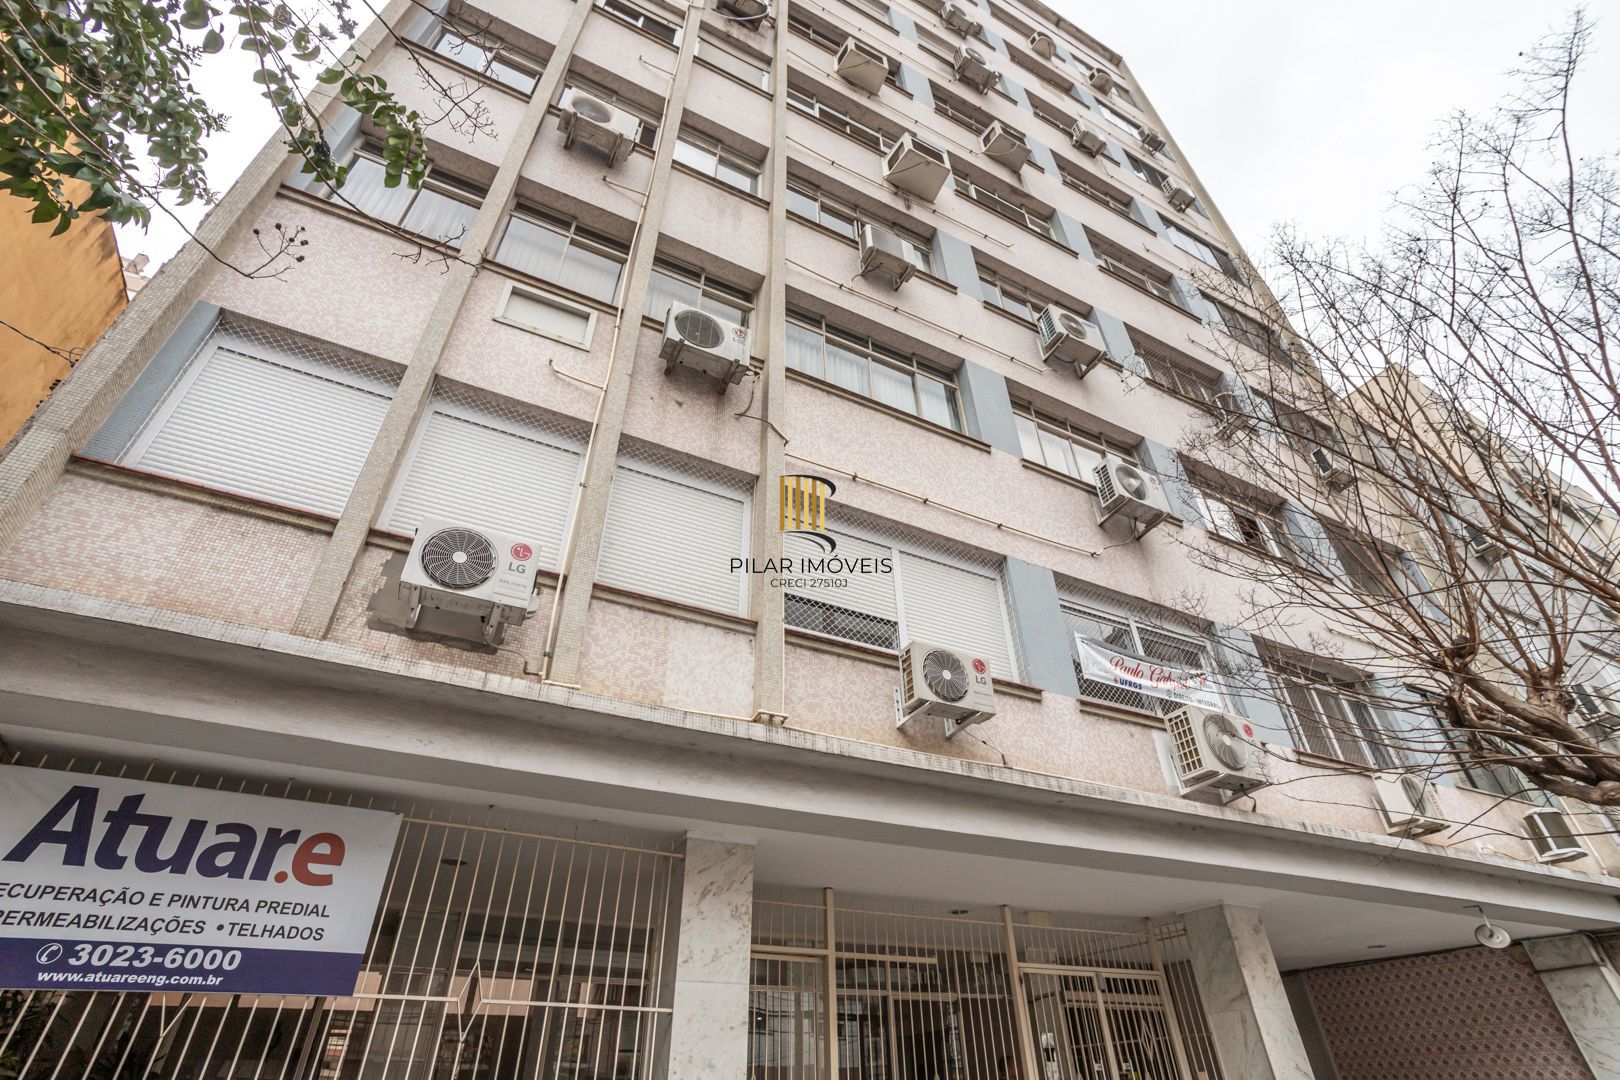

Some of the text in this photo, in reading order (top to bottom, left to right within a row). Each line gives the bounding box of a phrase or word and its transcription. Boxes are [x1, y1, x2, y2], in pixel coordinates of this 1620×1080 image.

[508, 562, 527, 574] LG
[1110, 655, 1144, 680] Paulo
[976, 675, 987, 686] LG
[1119, 678, 1143, 691] UFRGS
[2, 785, 346, 887] Atuar.e
[149, 892, 165, 907] E
[167, 893, 250, 913] PINTURA
[255, 899, 331, 918] PREDIAL
[228, 922, 325, 941] TELHADOS
[67, 943, 242, 971] 3023-6000
[37, 969, 224, 988] www.atuareeng.com.br
